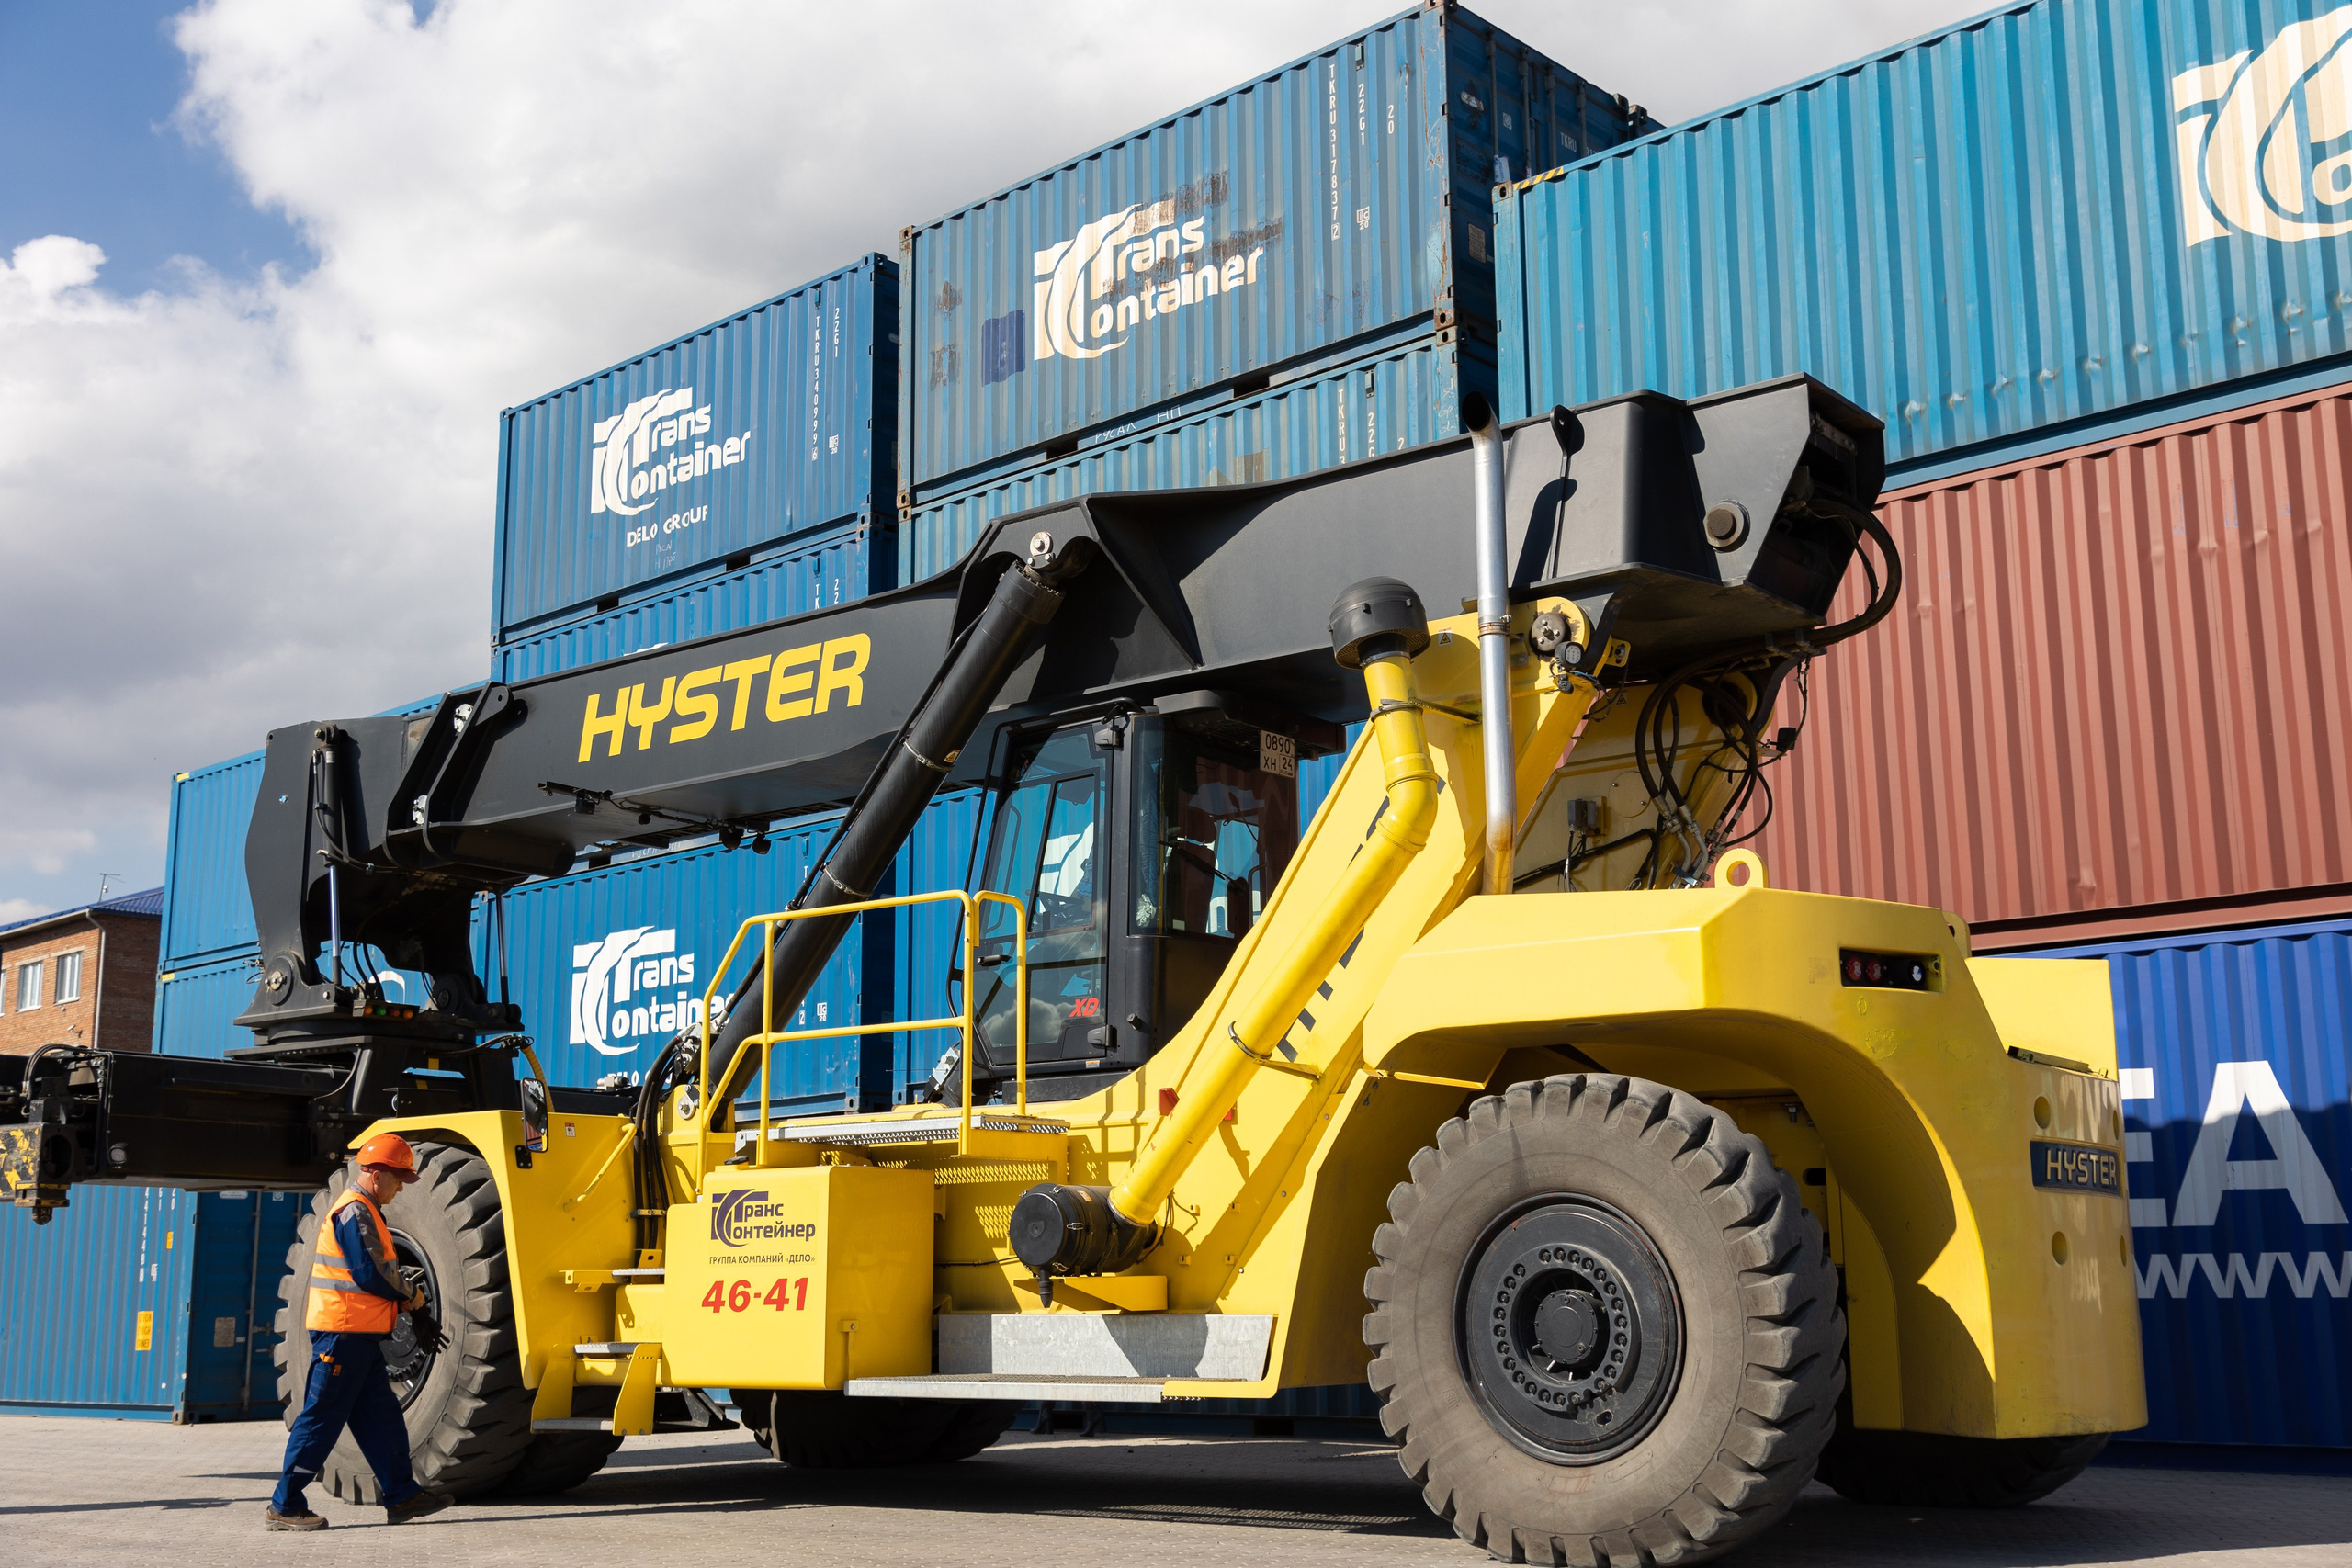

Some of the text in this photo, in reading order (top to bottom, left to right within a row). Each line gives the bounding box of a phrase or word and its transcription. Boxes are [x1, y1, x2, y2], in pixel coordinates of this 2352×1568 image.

[1387, 105, 1395, 134] 20
[627, 504, 708, 547] DELO GROUP
[577, 633, 871, 762] HYSTER
[1266, 734, 1291, 754] 0890
[1283, 757, 1293, 771] 24
[1069, 998, 1099, 1018] XD
[2046, 1150, 2117, 1186] HYSTER
[709, 1253, 815, 1265] ГРУППА КОМПАНИЙ «ДЕЛО»
[701, 1278, 808, 1314] 46-41
